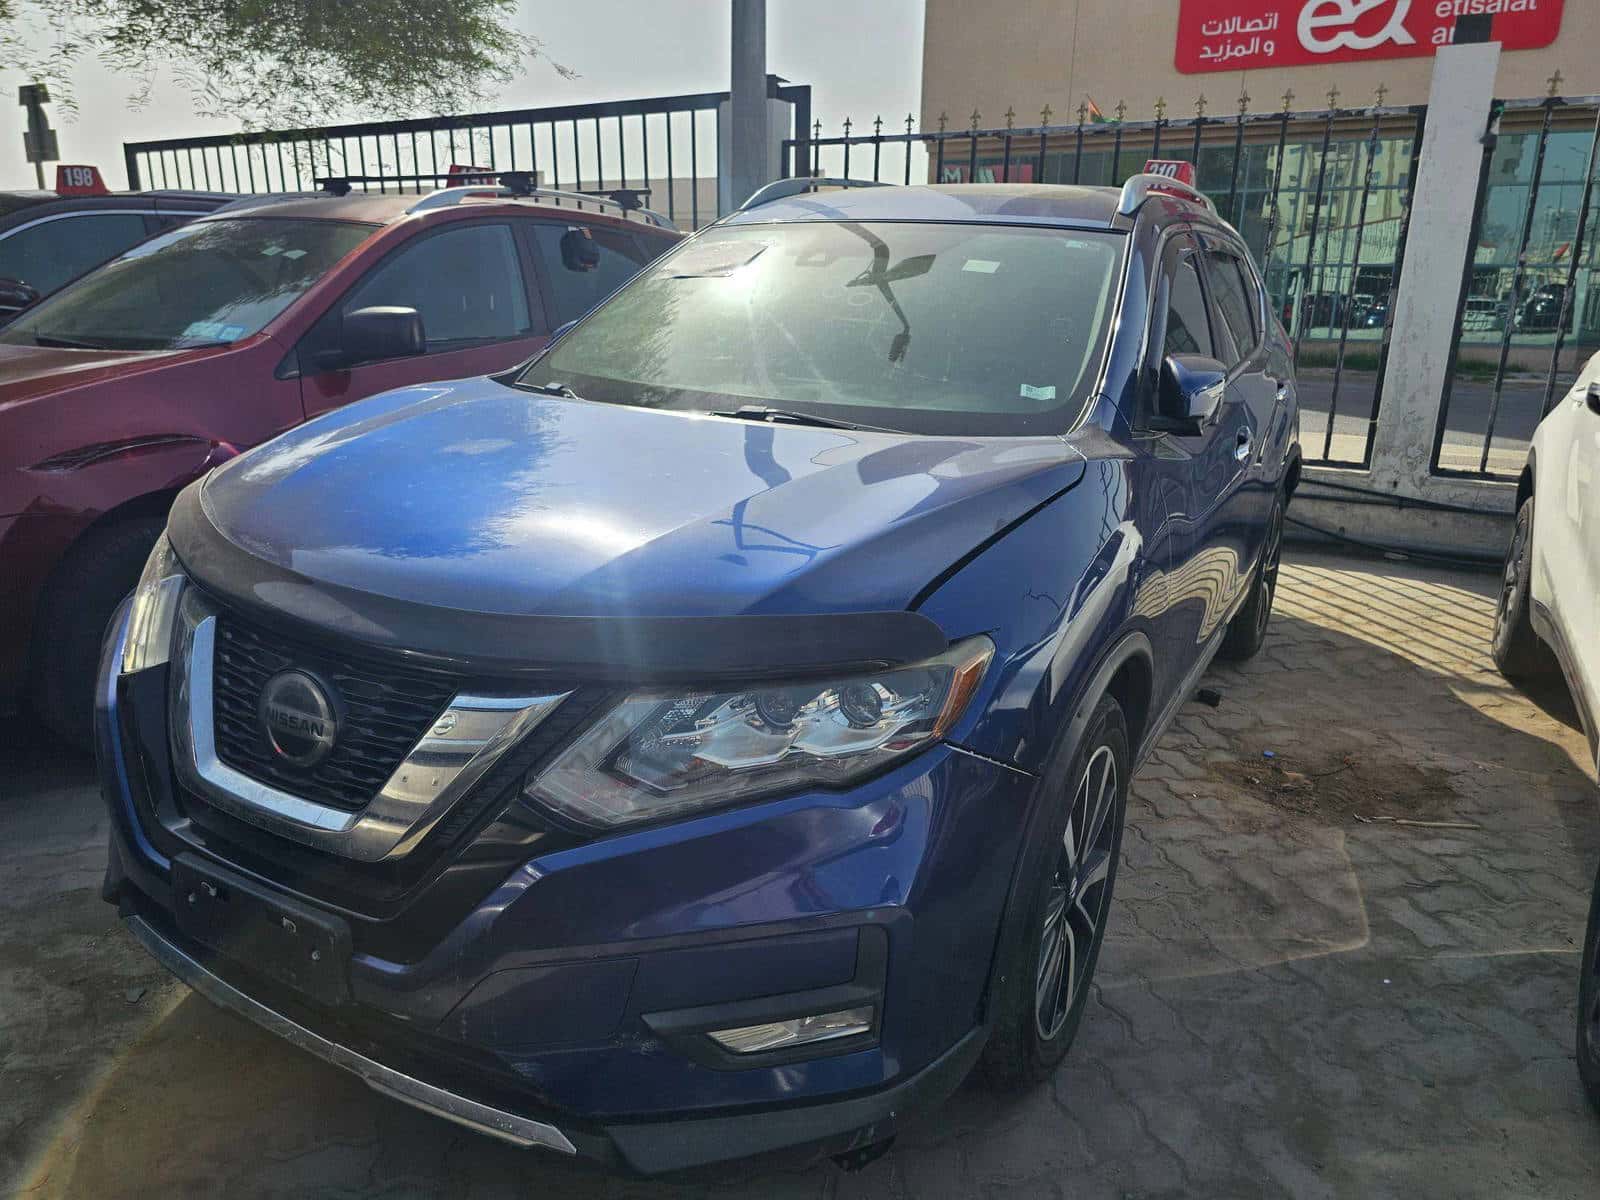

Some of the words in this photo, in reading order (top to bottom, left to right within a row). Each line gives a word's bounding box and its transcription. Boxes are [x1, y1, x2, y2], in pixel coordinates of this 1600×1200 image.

[1201, 12, 1278, 36] اتصالات
[63, 167, 94, 187] 198
[264, 704, 325, 738] NISSAN
